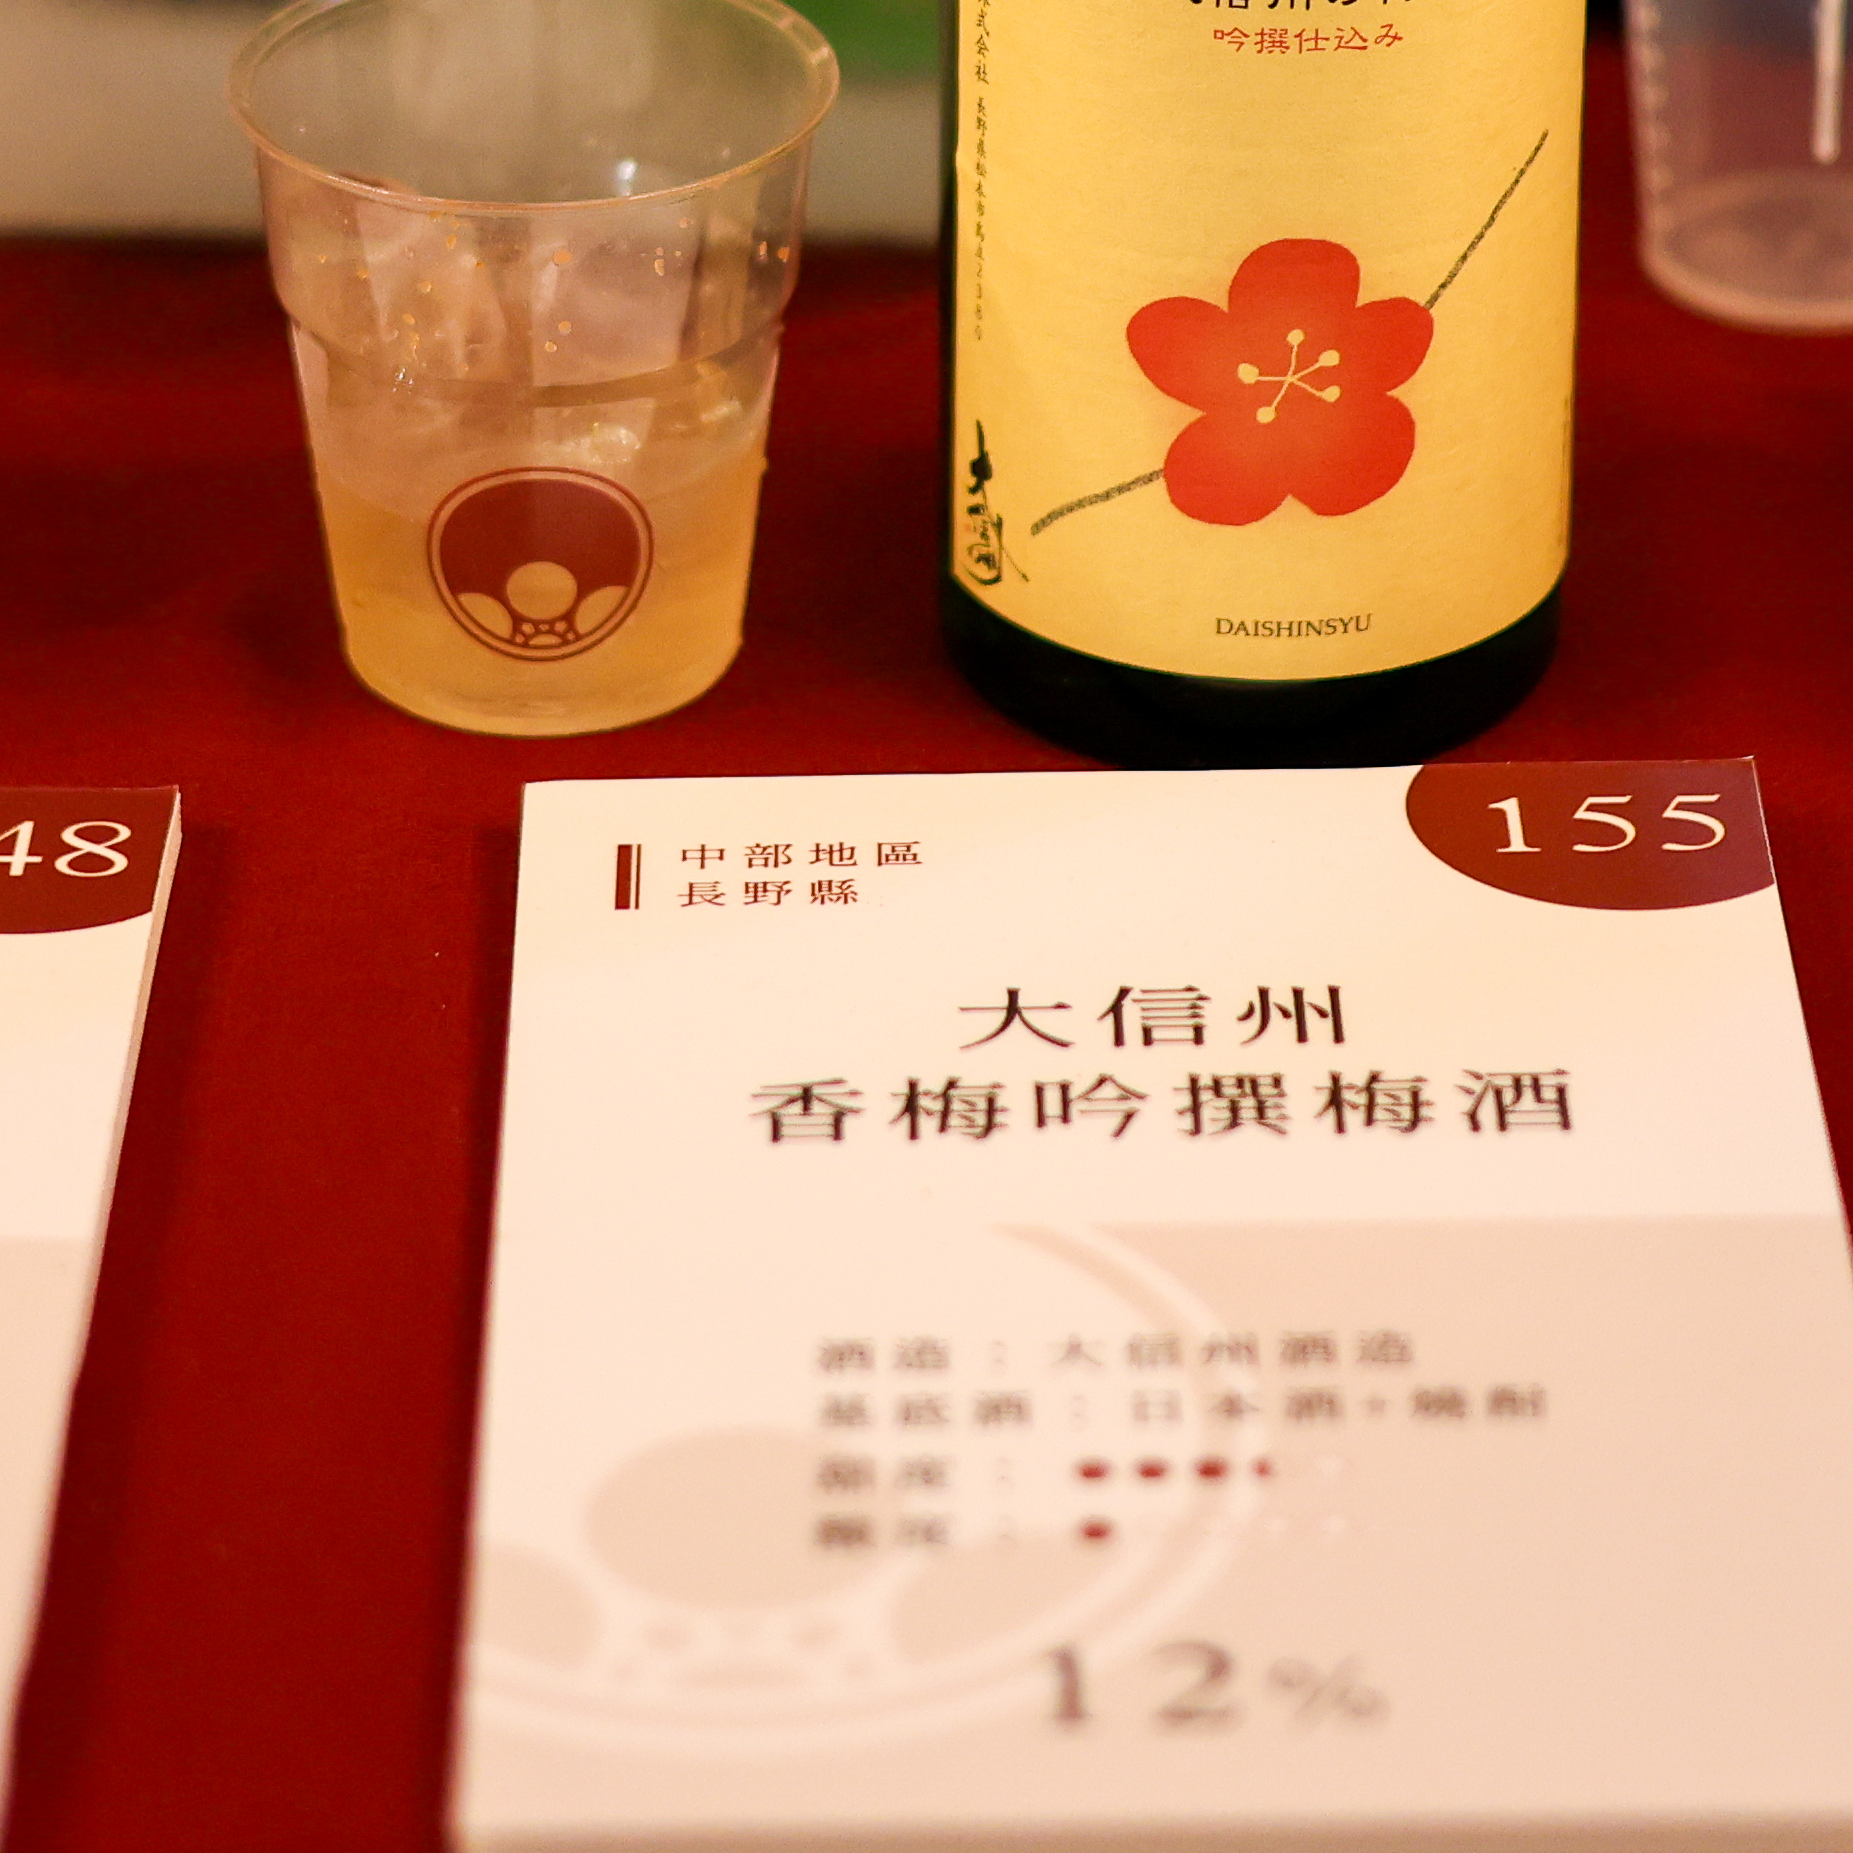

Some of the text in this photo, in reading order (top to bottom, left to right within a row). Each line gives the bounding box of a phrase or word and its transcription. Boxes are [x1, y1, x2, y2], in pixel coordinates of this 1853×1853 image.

[1213, 23, 1404, 55] 吟撰仕込み
[1215, 613, 1372, 637] DAISHINSYU
[1486, 792, 1729, 854] 155
[680, 840, 923, 869] 中部地區
[678, 878, 860, 908] 長野縣
[959, 984, 1347, 1051] 大信州
[749, 1069, 1574, 1144] 香梅吟撰梅酒
[1042, 1639, 1386, 1727] 12%
